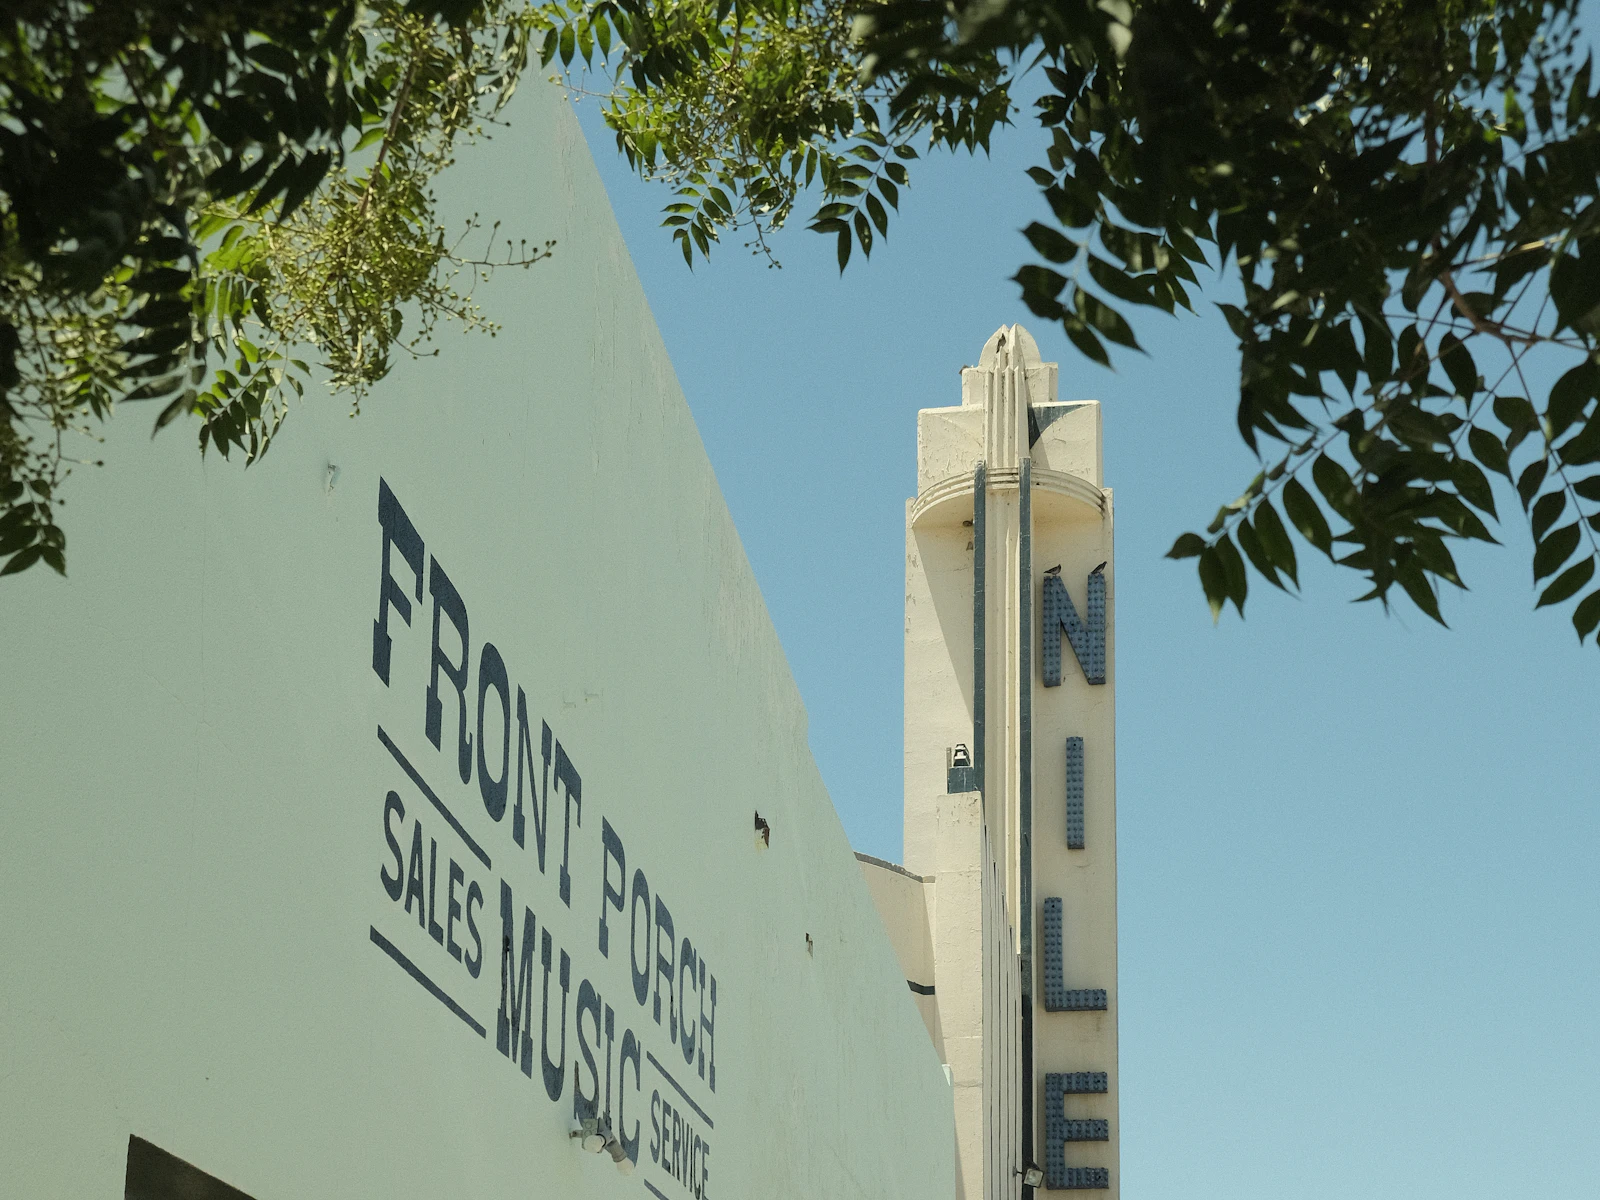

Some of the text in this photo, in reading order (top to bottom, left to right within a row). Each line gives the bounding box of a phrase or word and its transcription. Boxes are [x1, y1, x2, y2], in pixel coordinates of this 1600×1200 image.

[372, 475, 718, 1093] FRONT PORCH
[380, 789, 483, 979] SALES
[1042, 573, 1110, 1190] NILE
[496, 877, 642, 1169] MUSIC
